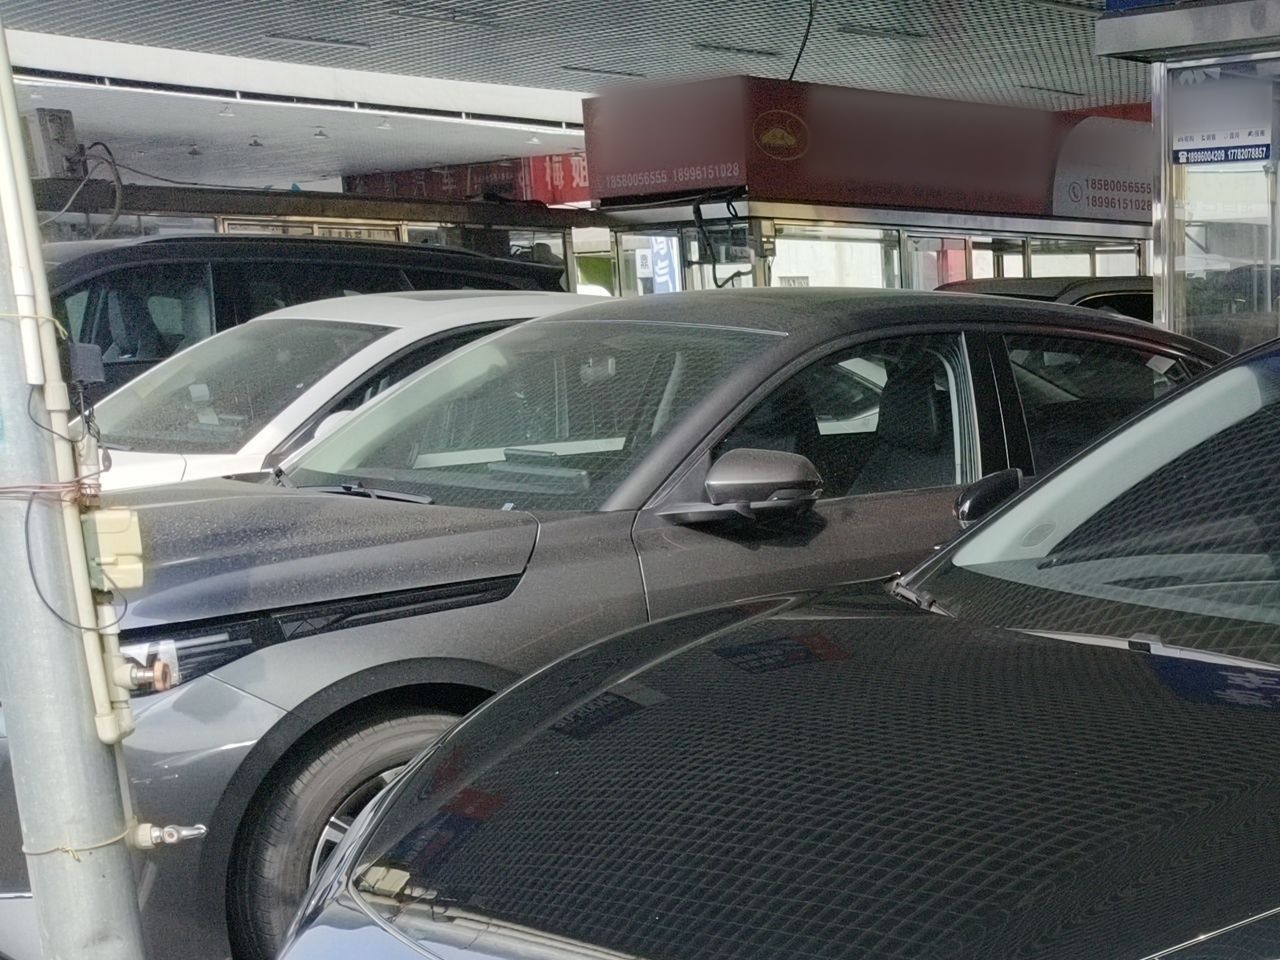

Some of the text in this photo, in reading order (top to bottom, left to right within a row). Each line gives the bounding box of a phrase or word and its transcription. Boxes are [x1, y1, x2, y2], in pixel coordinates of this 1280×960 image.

[606, 162, 740, 189] 18580056555 18996151028
[1086, 178, 1152, 194] 18580056555
[1086, 196, 1153, 211] 18996151028
